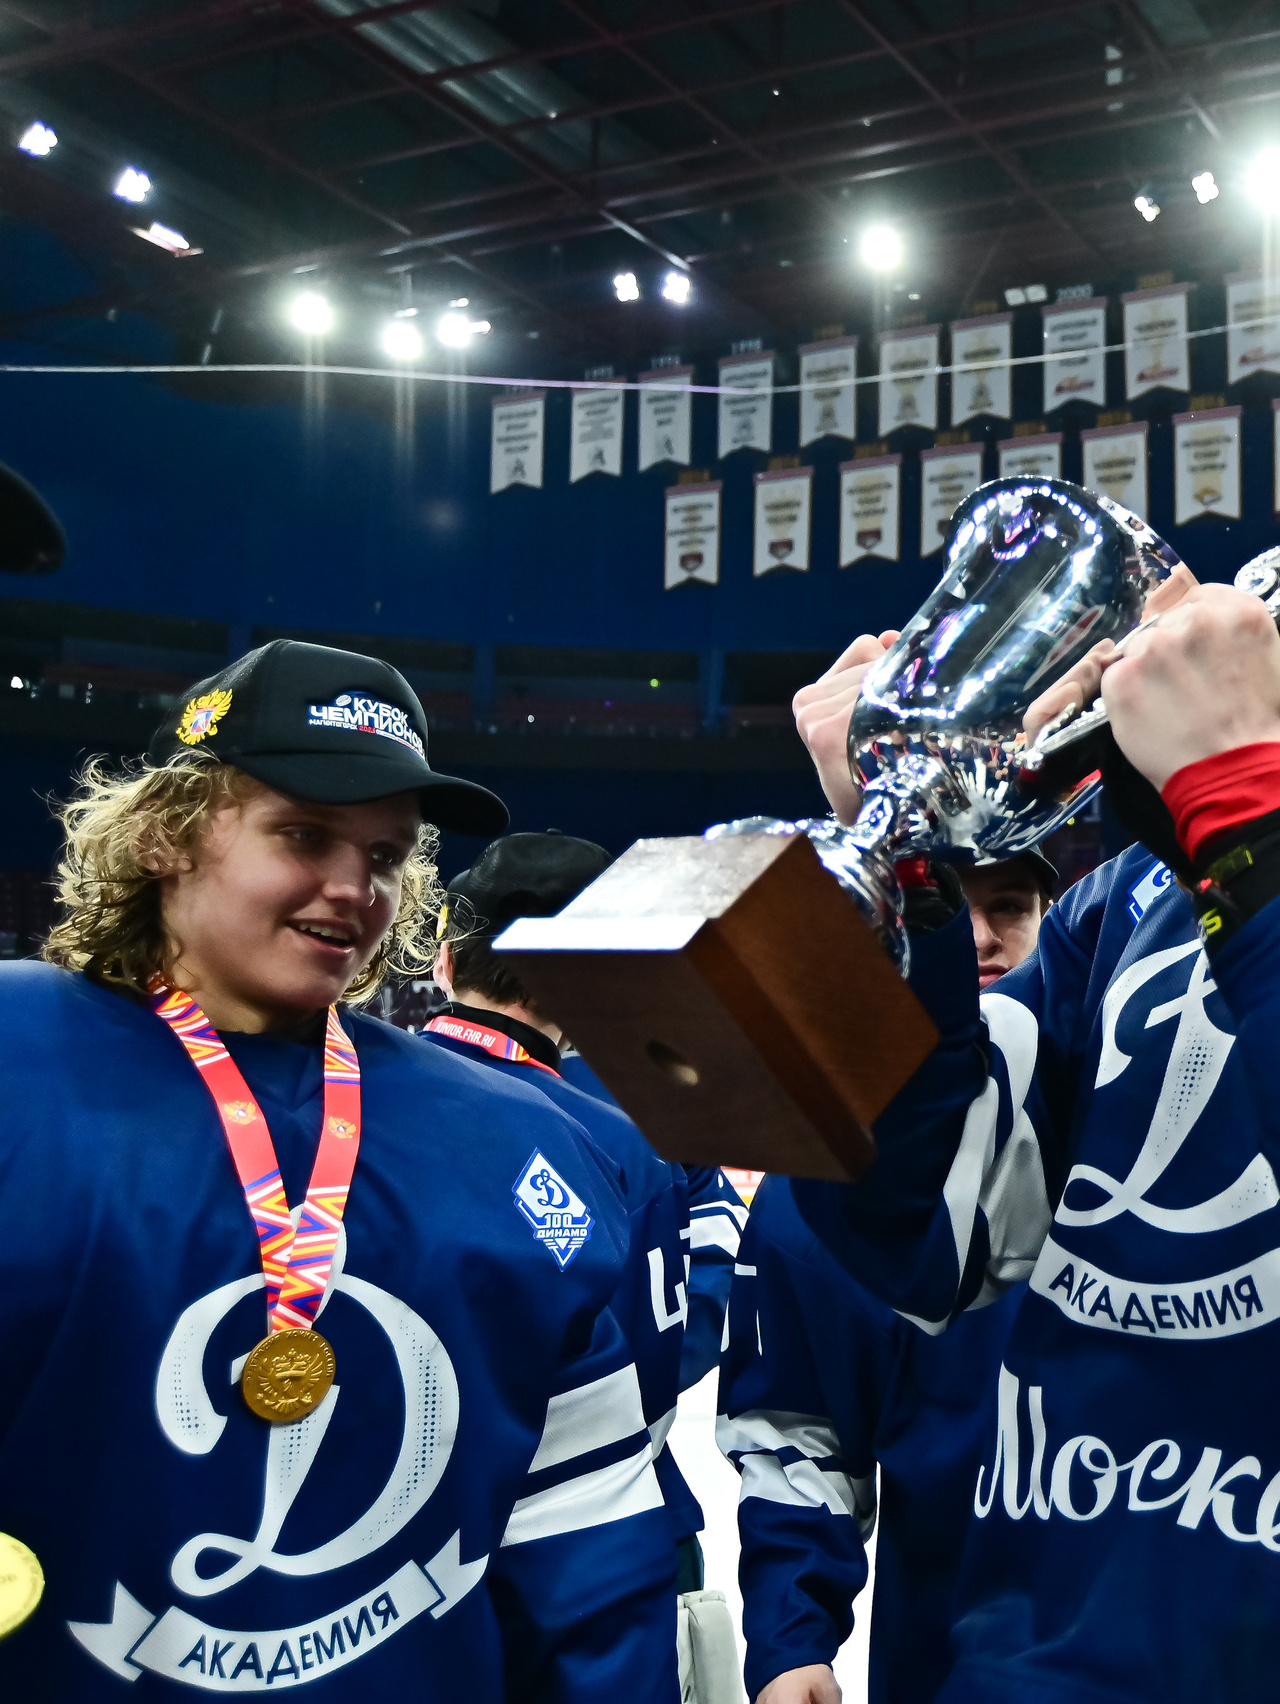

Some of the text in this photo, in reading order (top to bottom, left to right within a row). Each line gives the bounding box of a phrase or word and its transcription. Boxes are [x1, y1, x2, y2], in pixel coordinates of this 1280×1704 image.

[353, 697, 409, 727] КУБОК
[310, 705, 424, 754] ЧЕМПИОНОВ
[434, 1021, 496, 1048] JUNIOR.FHR.RU
[536, 1228, 588, 1239] ДИНАМО
[544, 1213, 573, 1228] 100
[1049, 1263, 1264, 1334] АКАДЕМИЯ
[177, 1590, 400, 1685] АКАДЕМИЯ
